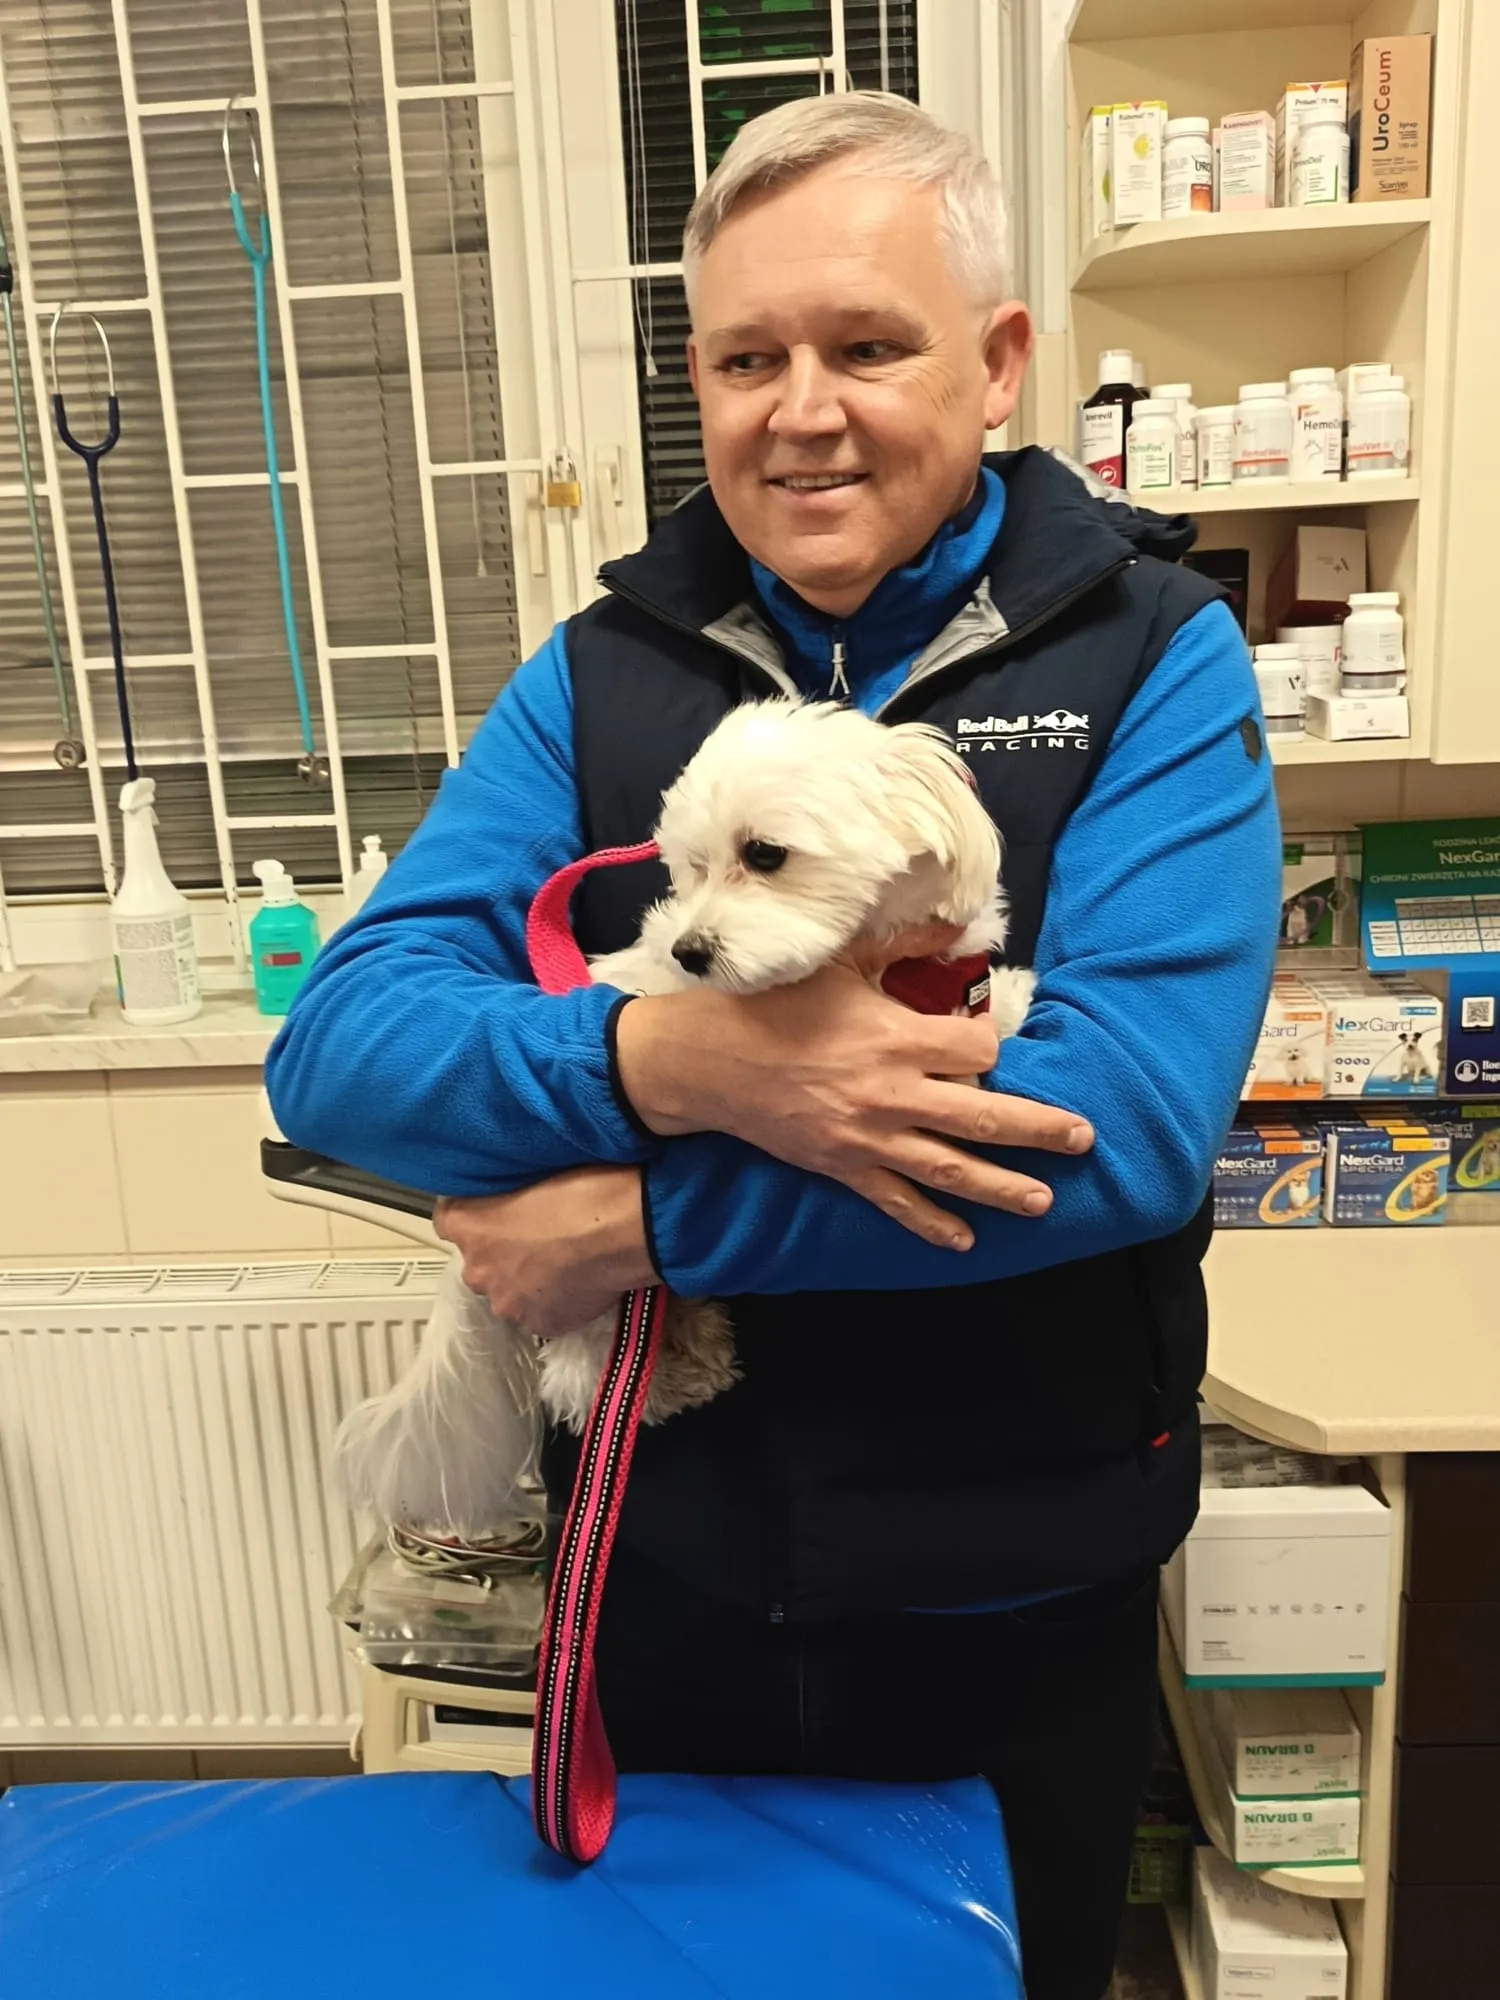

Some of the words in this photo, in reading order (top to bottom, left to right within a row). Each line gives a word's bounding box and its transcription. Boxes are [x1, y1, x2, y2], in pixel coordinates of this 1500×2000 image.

[1372, 50, 1392, 152] UroCeum
[957, 716, 994, 734] Red
[994, 715, 1029, 733] Bull
[956, 738, 1090, 753] RACING
[1334, 1072, 1342, 1083] 3
[1214, 1157, 1277, 1169] NexGard
[1340, 1154, 1404, 1166] NexGard
